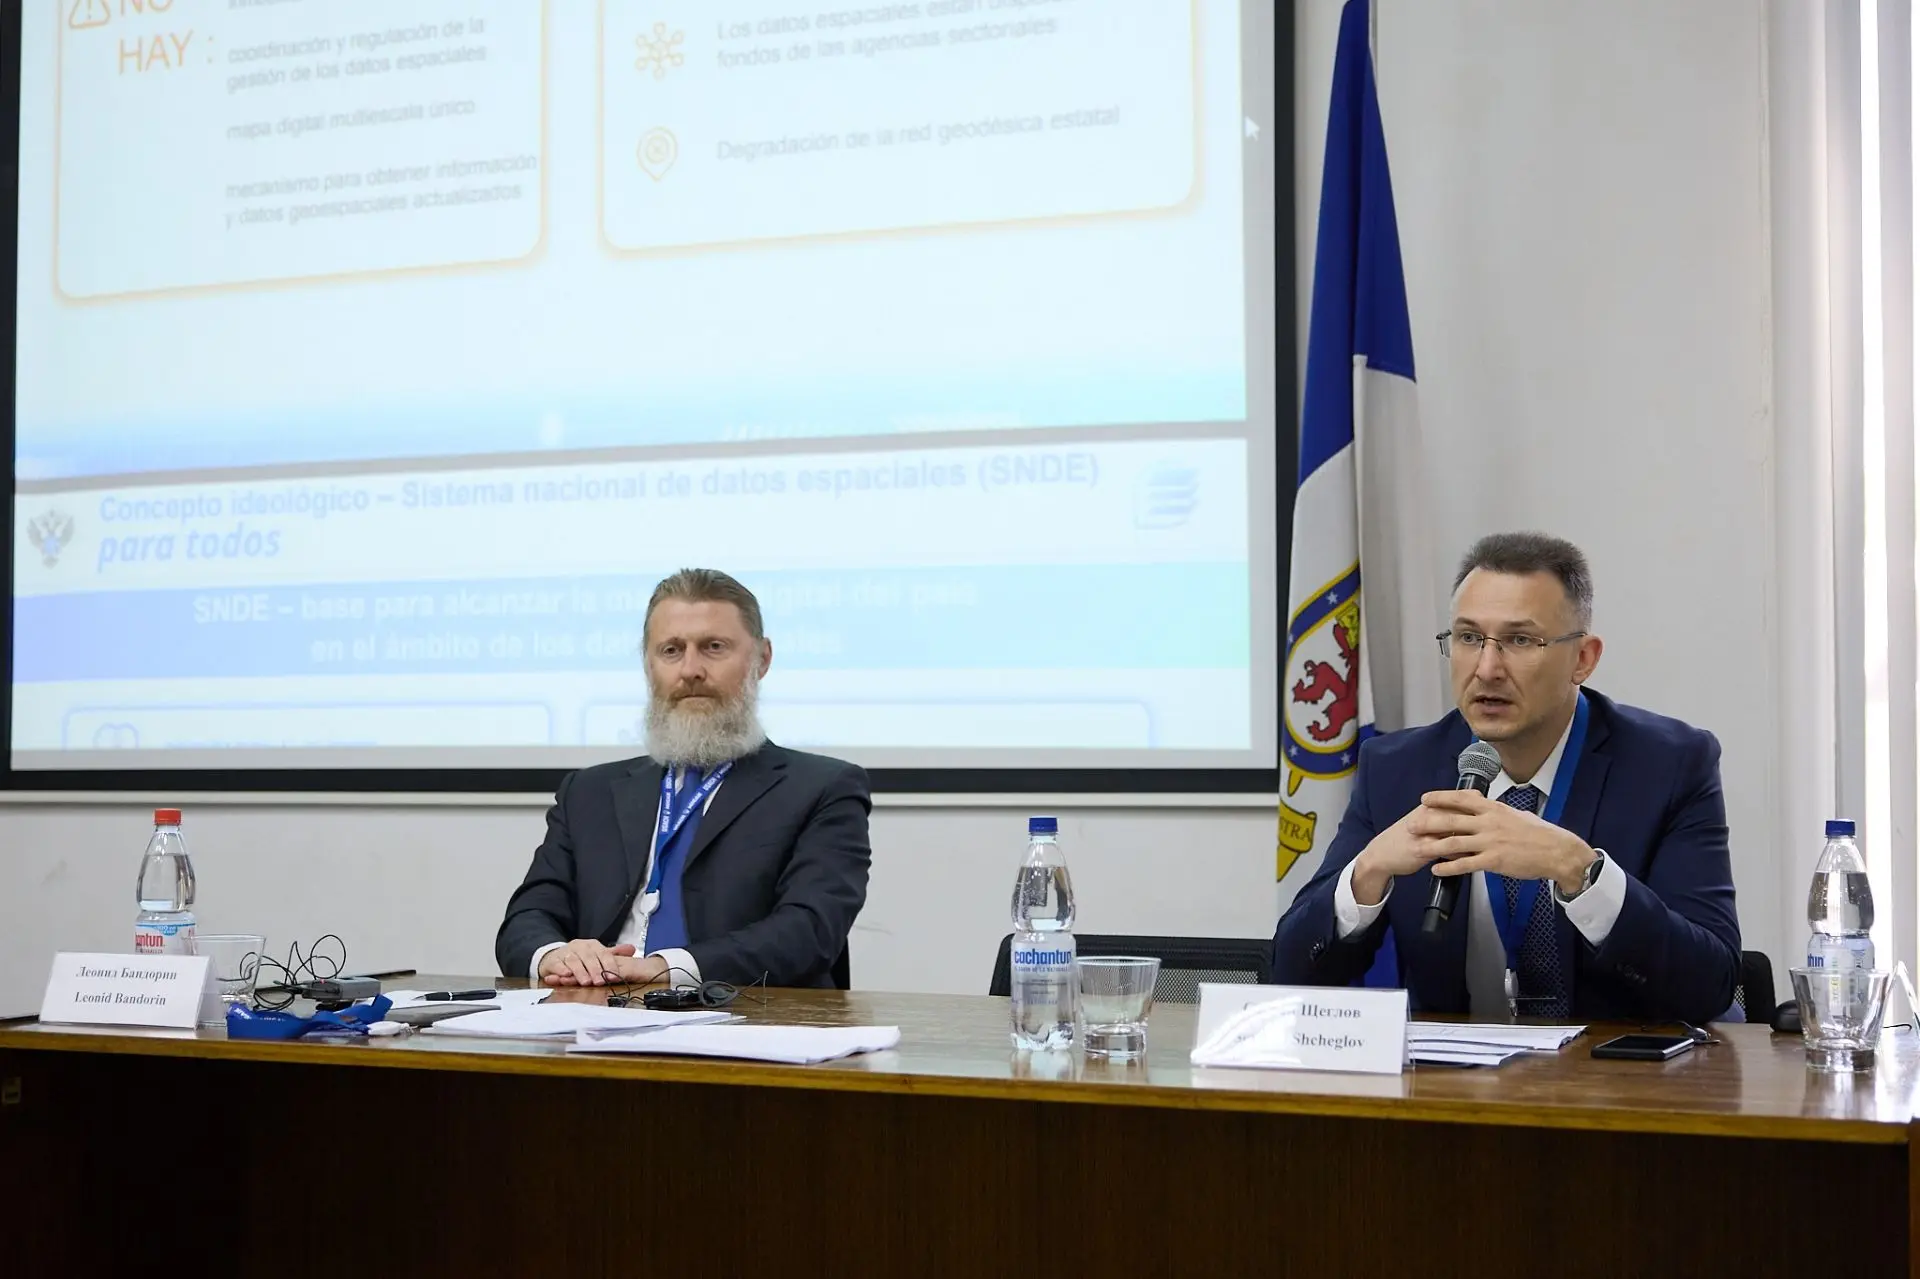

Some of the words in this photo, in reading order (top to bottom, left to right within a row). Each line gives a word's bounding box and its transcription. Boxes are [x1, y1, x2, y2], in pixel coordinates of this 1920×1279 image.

[441, 19, 466, 39] de
[468, 16, 486, 35] la
[716, 46, 782, 68] fondos
[786, 43, 812, 62] de
[817, 39, 845, 59] las
[851, 28, 941, 58] agencias
[947, 16, 1059, 45] sectoriales
[757, 14, 811, 36] datos
[119, 28, 194, 76] HAY
[290, 64, 311, 83] de
[316, 62, 340, 80] los
[345, 56, 392, 77] datos
[396, 45, 488, 72] espaciales
[226, 121, 272, 141] mapa
[276, 114, 325, 138] digital
[716, 132, 839, 163] Degradación
[846, 129, 871, 149] de
[876, 125, 895, 146] la
[900, 120, 931, 144] red
[938, 111, 1044, 146] geodésica
[1050, 104, 1121, 131] estatal
[226, 175, 320, 199] mecanismo
[324, 171, 362, 194] para
[366, 164, 432, 187] obtener
[435, 154, 538, 180] información
[238, 206, 284, 225] datos
[289, 195, 408, 226] geoespaciales
[413, 184, 523, 208] actualizados
[99, 495, 222, 525] Concepto
[231, 484, 370, 520] ideológico
[402, 478, 514, 509] Sistema
[523, 470, 648, 503] nacional
[656, 467, 692, 499] de
[702, 465, 787, 496] datos
[797, 459, 968, 501] espaciales
[977, 453, 1101, 493] (SNDE)
[97, 529, 175, 574] para
[185, 522, 282, 560] todos
[193, 593, 271, 624] SNDE
[302, 593, 366, 621] base
[375, 592, 435, 628] para
[443, 586, 563, 618] alcanzar
[310, 636, 344, 664] en
[353, 631, 377, 661] el
[489, 630, 524, 659] de
[75, 966, 118, 979] Леонид
[120, 967, 177, 983] Бандорин
[1014, 948, 1072, 965] cachantun
[75, 991, 112, 1004] Leonid
[115, 992, 166, 1006] Bandorin
[1301, 1004, 1361, 1019] Щеглов
[1293, 1032, 1366, 1050] Shcheglov
